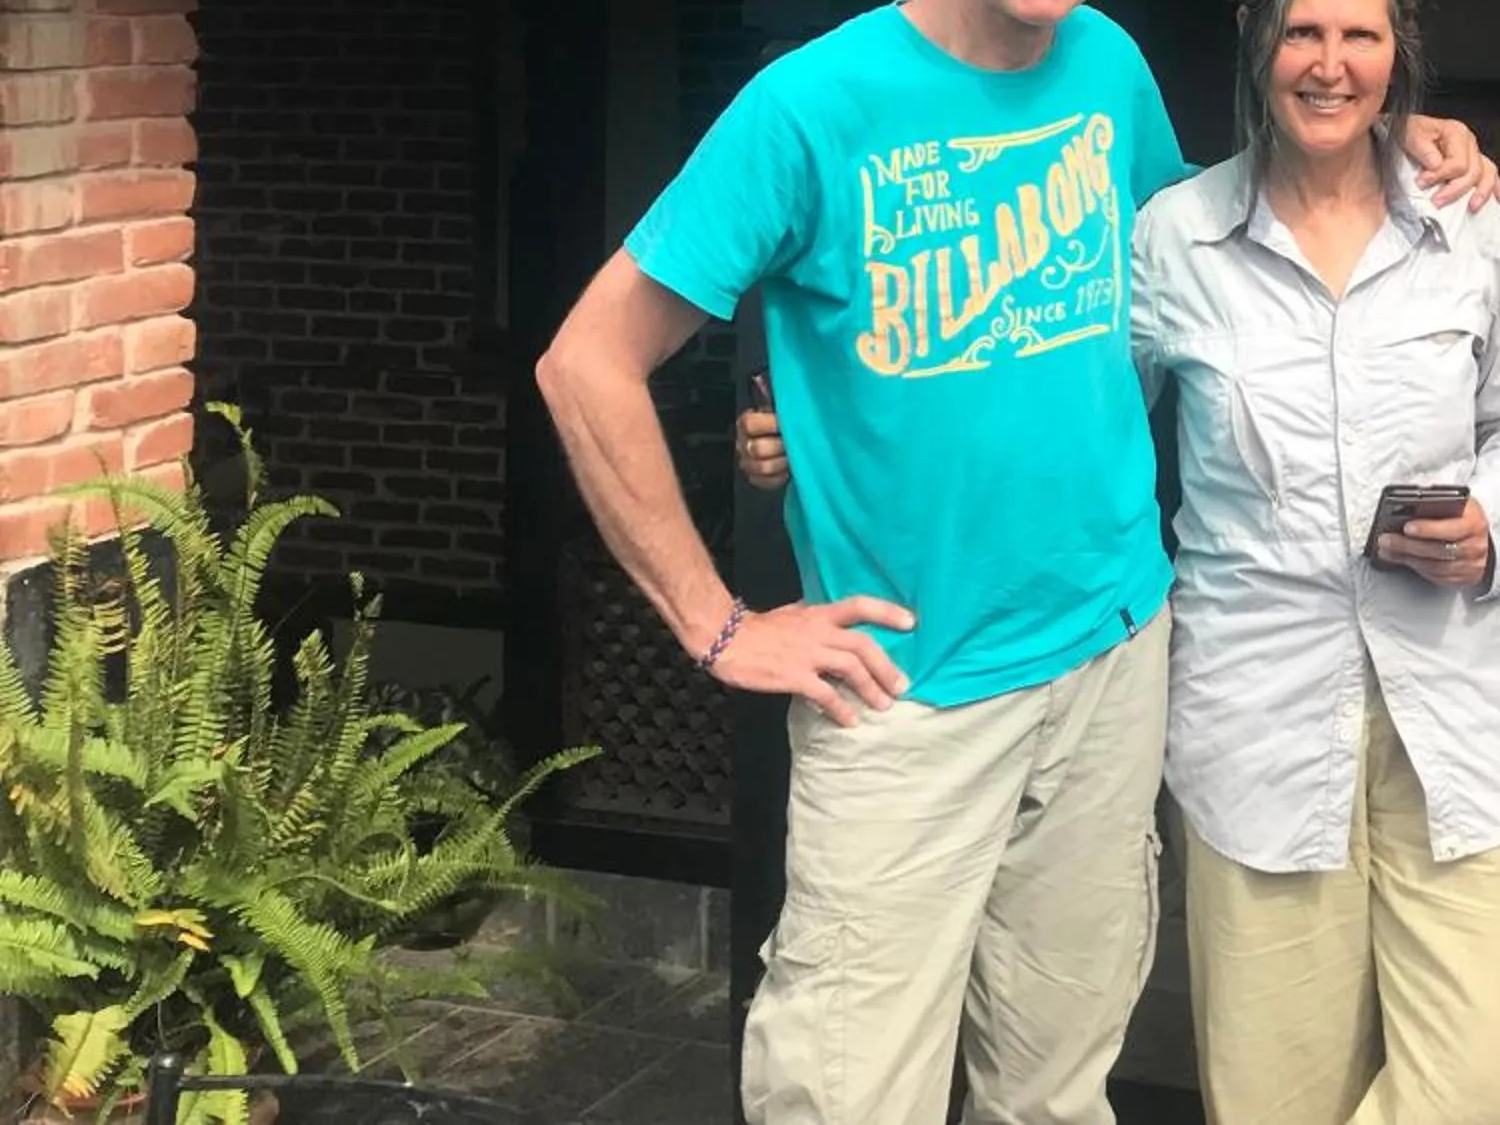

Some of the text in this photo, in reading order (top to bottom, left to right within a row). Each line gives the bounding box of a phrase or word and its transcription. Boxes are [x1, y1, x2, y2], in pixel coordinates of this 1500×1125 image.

[869, 141, 940, 187] MADE
[905, 170, 950, 205] FOR
[896, 199, 981, 240] LIVING
[856, 113, 1115, 375] BILLABONG
[991, 294, 1067, 338] SINCE
